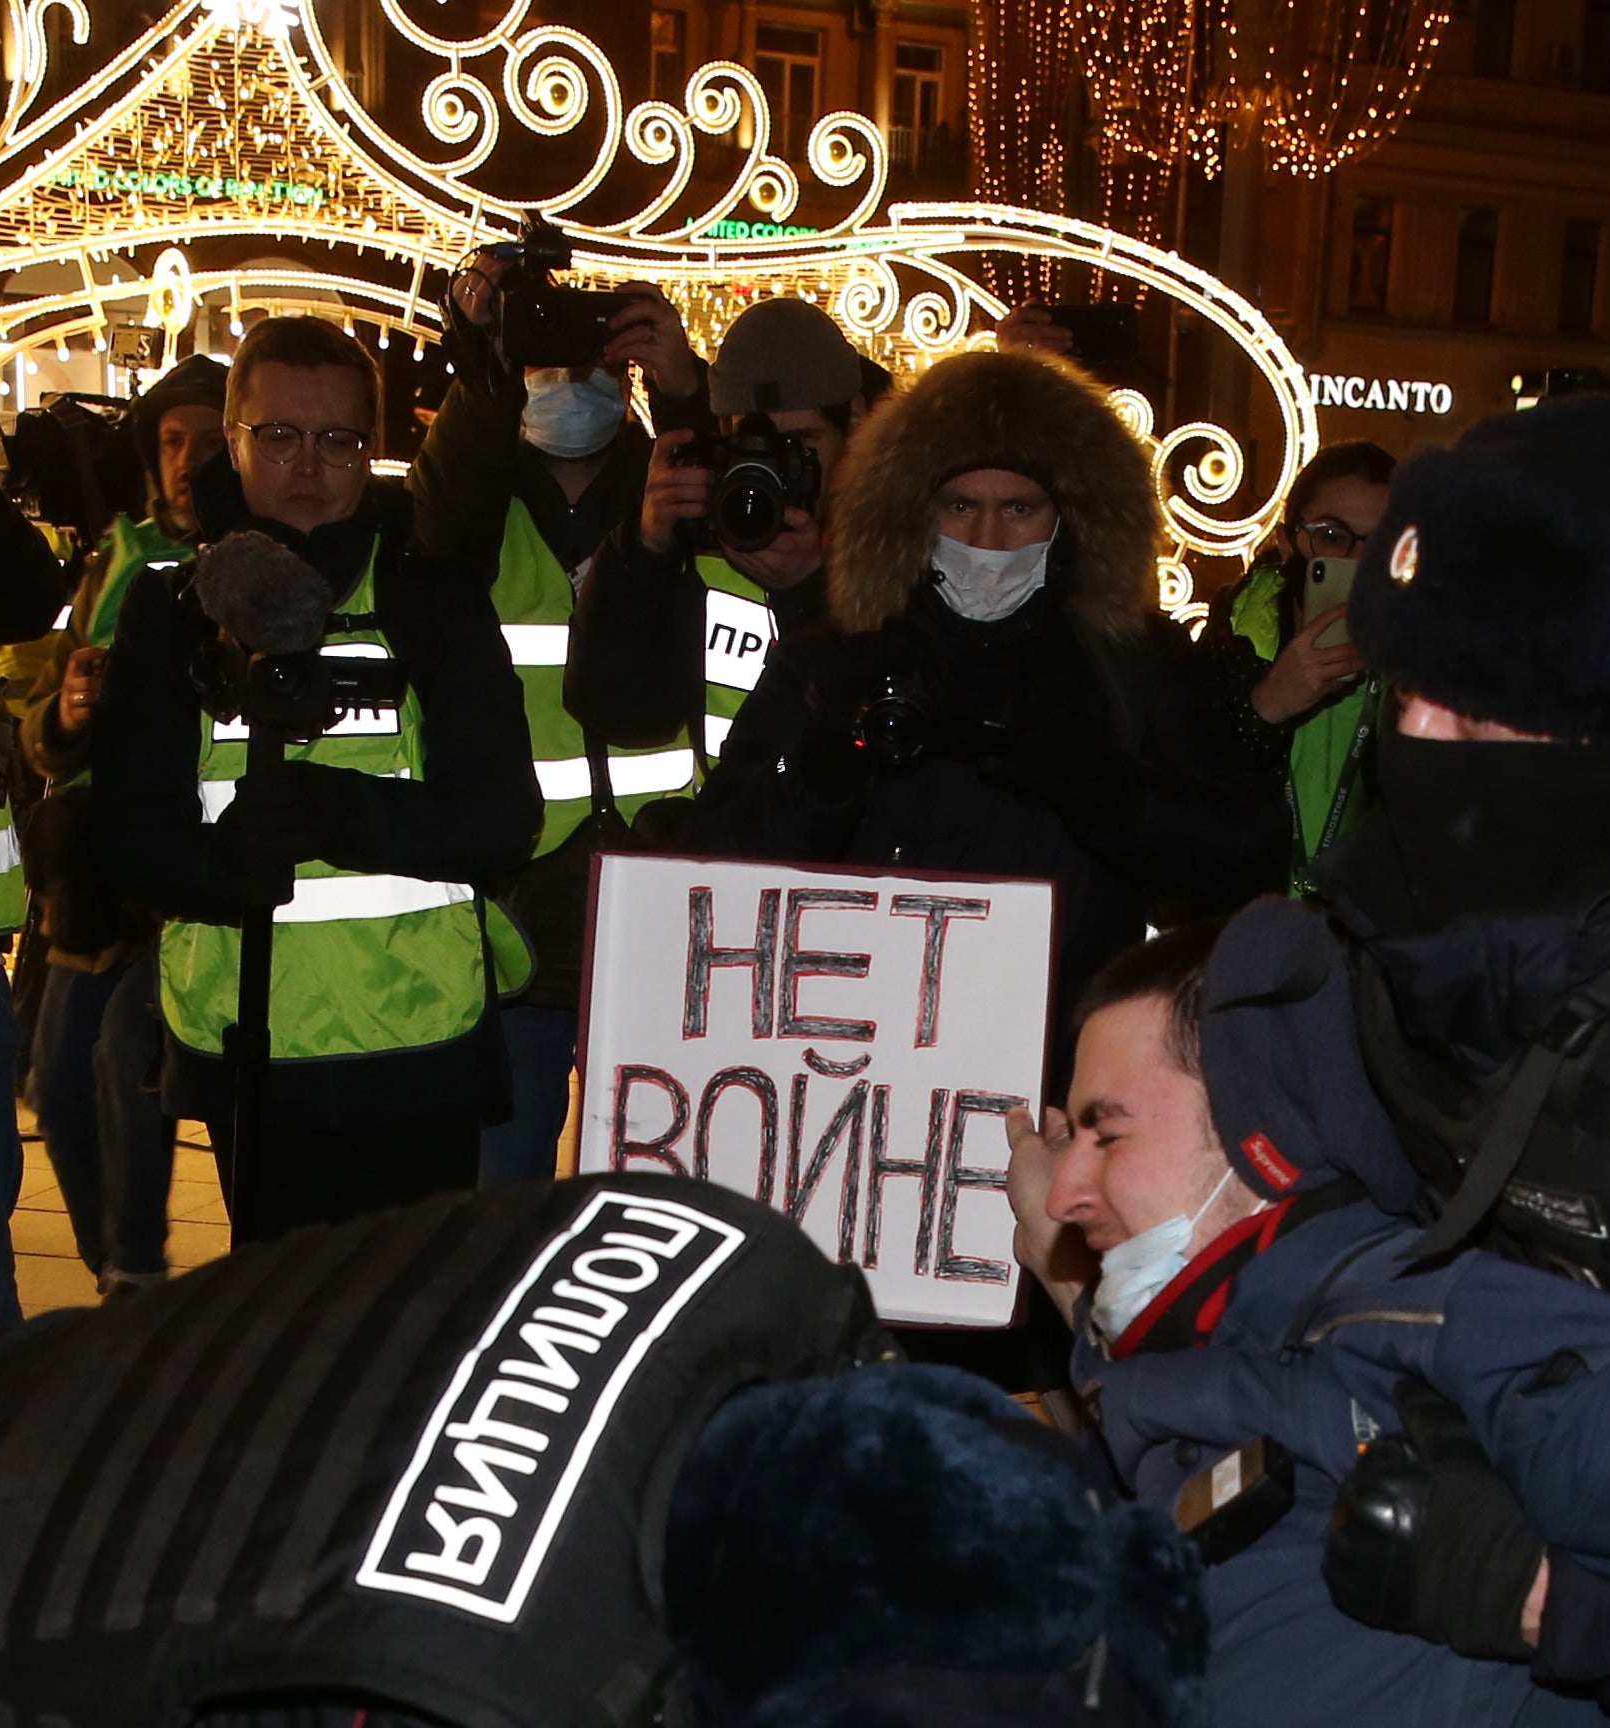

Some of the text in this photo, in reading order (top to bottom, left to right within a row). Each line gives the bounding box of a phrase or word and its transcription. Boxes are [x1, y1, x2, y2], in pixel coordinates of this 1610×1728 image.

[1309, 374, 1452, 414] INCANTO
[682, 886, 992, 1049] НЕТ
[612, 1047, 1030, 1284] ВОЙНЕ
[1249, 1140, 1291, 1186] Supreme
[404, 1206, 702, 1588] ПОЛИЦИЯ
